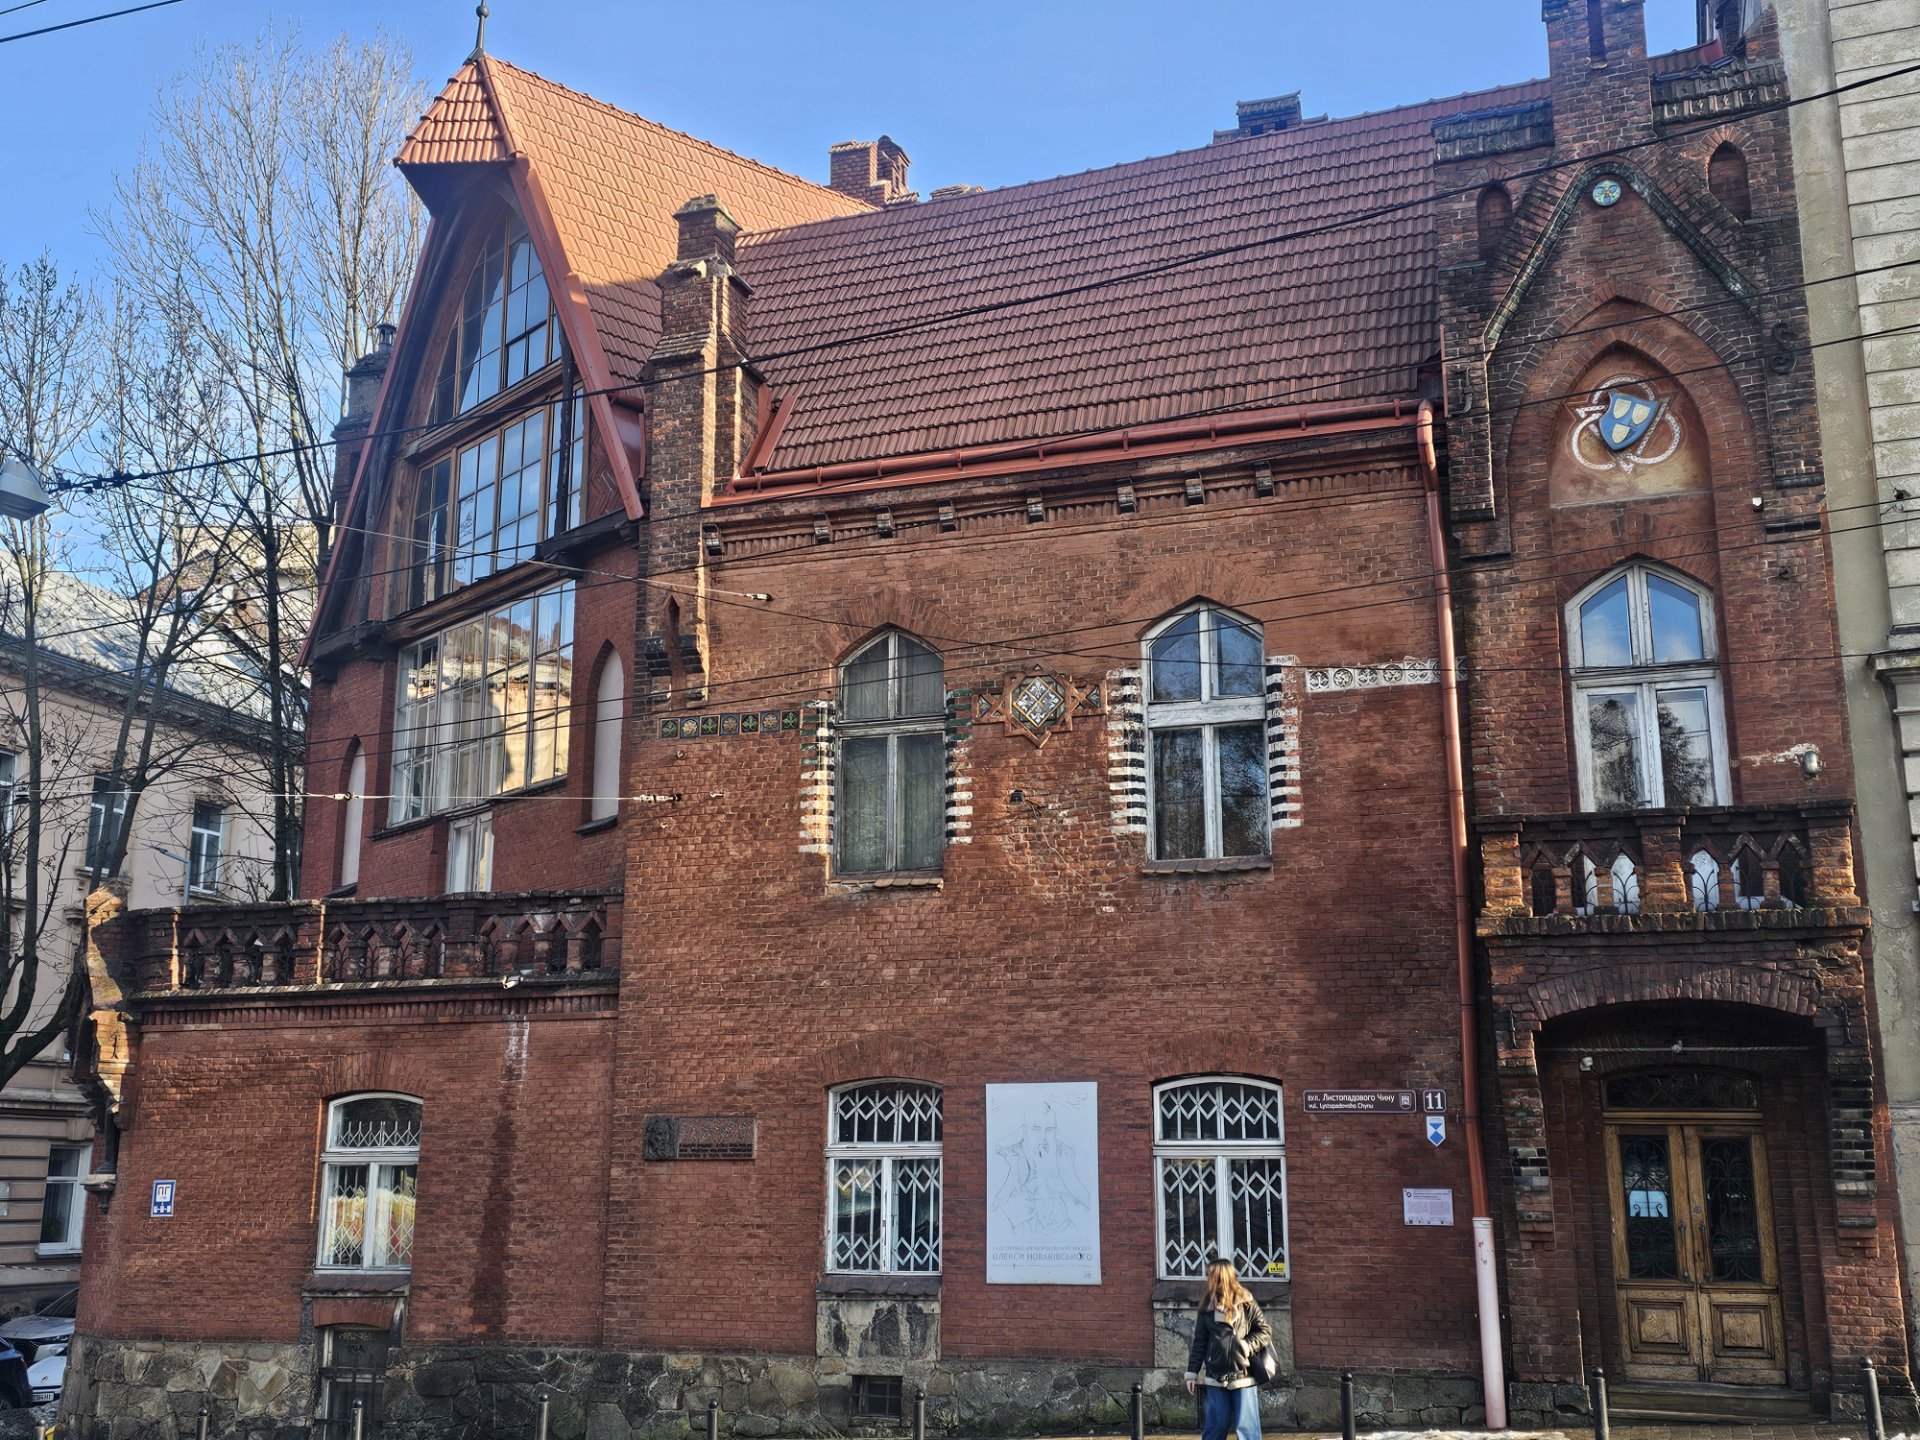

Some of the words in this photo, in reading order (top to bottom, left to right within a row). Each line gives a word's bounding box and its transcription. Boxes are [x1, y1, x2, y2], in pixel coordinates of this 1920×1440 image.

[1322, 1093, 1376, 1103] Листопадового
[1377, 1093, 1395, 1104] Чину
[1425, 1092, 1444, 1110] 11
[1319, 1102, 1357, 1110] Lystopadovoho
[1357, 1102, 1374, 1110] Chynu
[992, 1252, 1025, 1261] ОЛЕКСИ
[1026, 1252, 1093, 1261] НОВАКІВСЬКОГО
